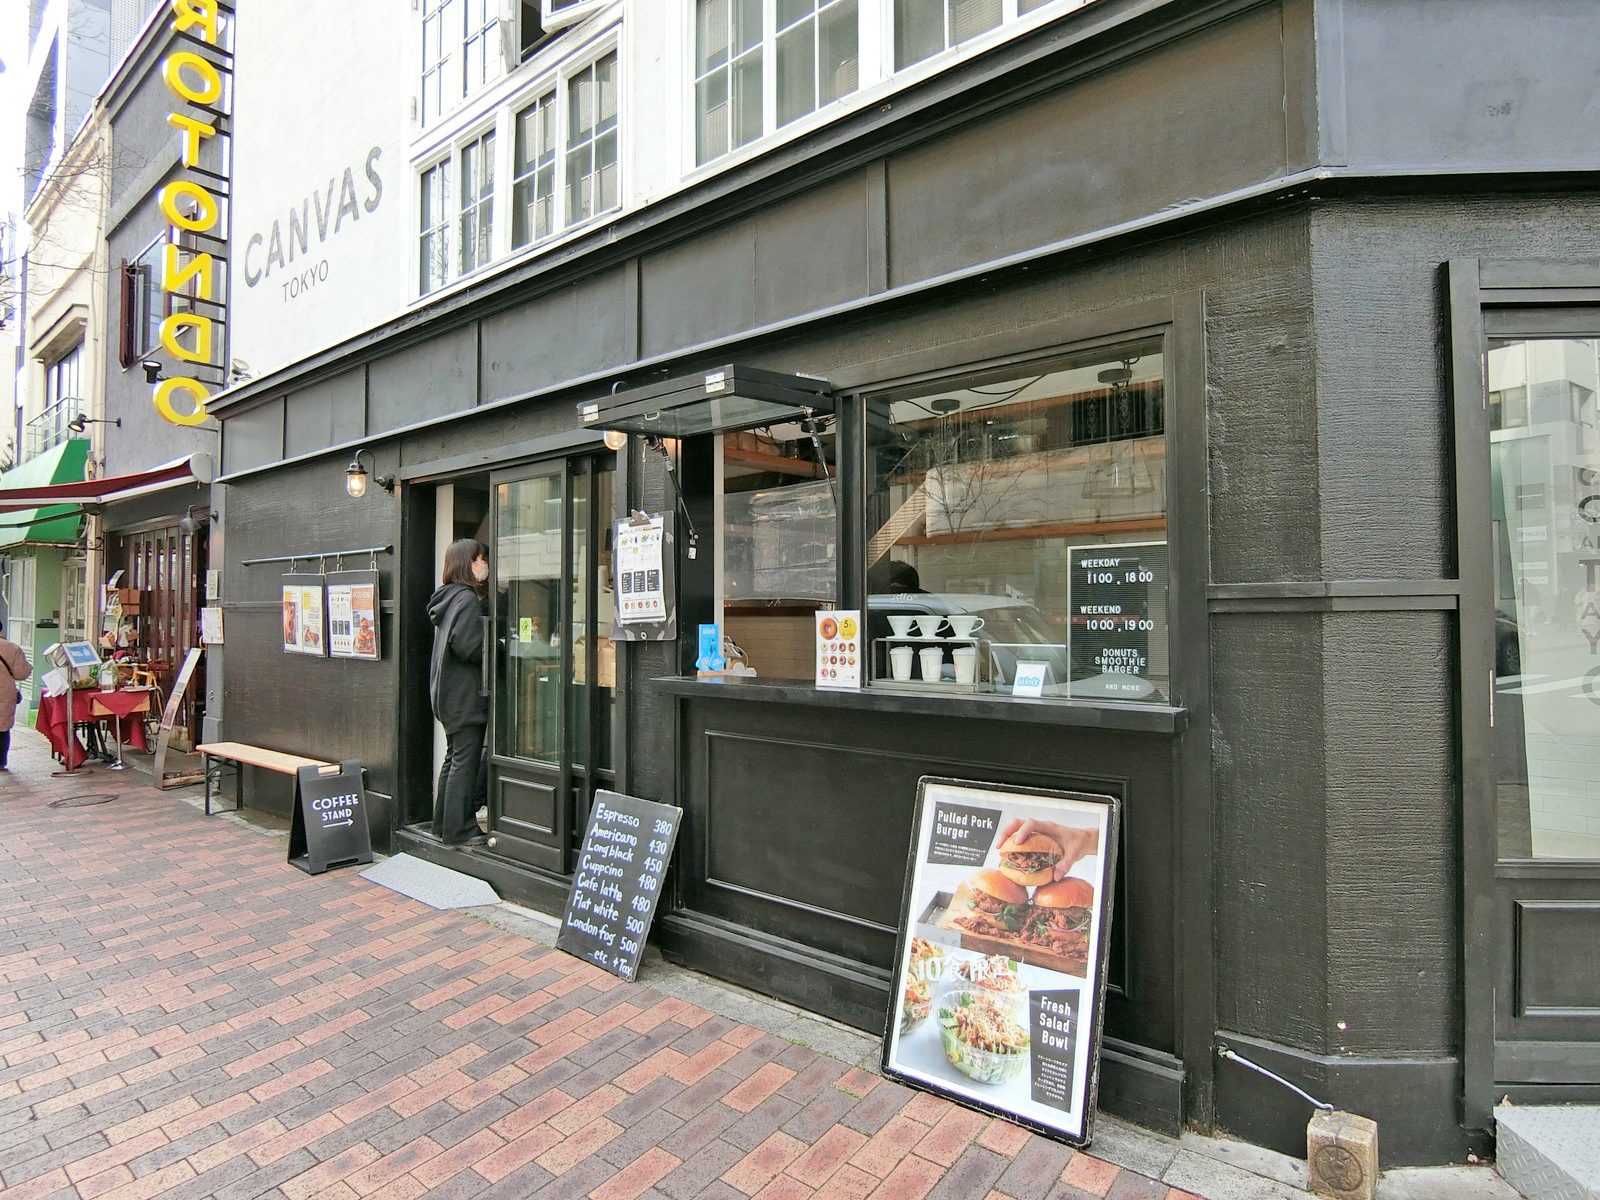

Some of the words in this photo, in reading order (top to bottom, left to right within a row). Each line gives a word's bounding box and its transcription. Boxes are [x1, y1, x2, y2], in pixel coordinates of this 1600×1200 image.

[244, 146, 383, 288] CANVAS
[282, 259, 329, 303] TOKYO
[1081, 558, 1120, 568] WEEKDAY
[1080, 605, 1121, 614] WEEKEND
[1094, 656, 1146, 666] SMOOTHIE
[1102, 648, 1138, 657] DONUTS
[1101, 665, 1139, 674] BARGER
[1017, 676, 1041, 687] Wolt
[311, 793, 360, 811] COFFEE
[321, 808, 353, 821] STAND
[595, 802, 640, 828] Espresso
[653, 819, 673, 835] 380
[937, 810, 968, 825] Pulled
[971, 815, 993, 829] Pork
[590, 822, 638, 847] Americano
[648, 839, 668, 855] 430
[936, 822, 970, 839] Burger
[643, 856, 663, 874] 450
[638, 873, 657, 891] 480
[577, 872, 599, 892] Cafe
[600, 879, 623, 902] latte
[631, 894, 651, 913] 480
[572, 889, 592, 911] Flat
[593, 899, 619, 921] white
[625, 915, 645, 934] 500
[619, 936, 638, 955] 500
[1040, 995, 1071, 1017] Fresh
[1039, 1012, 1070, 1033] Salad
[1041, 1029, 1068, 1051] Bowl
